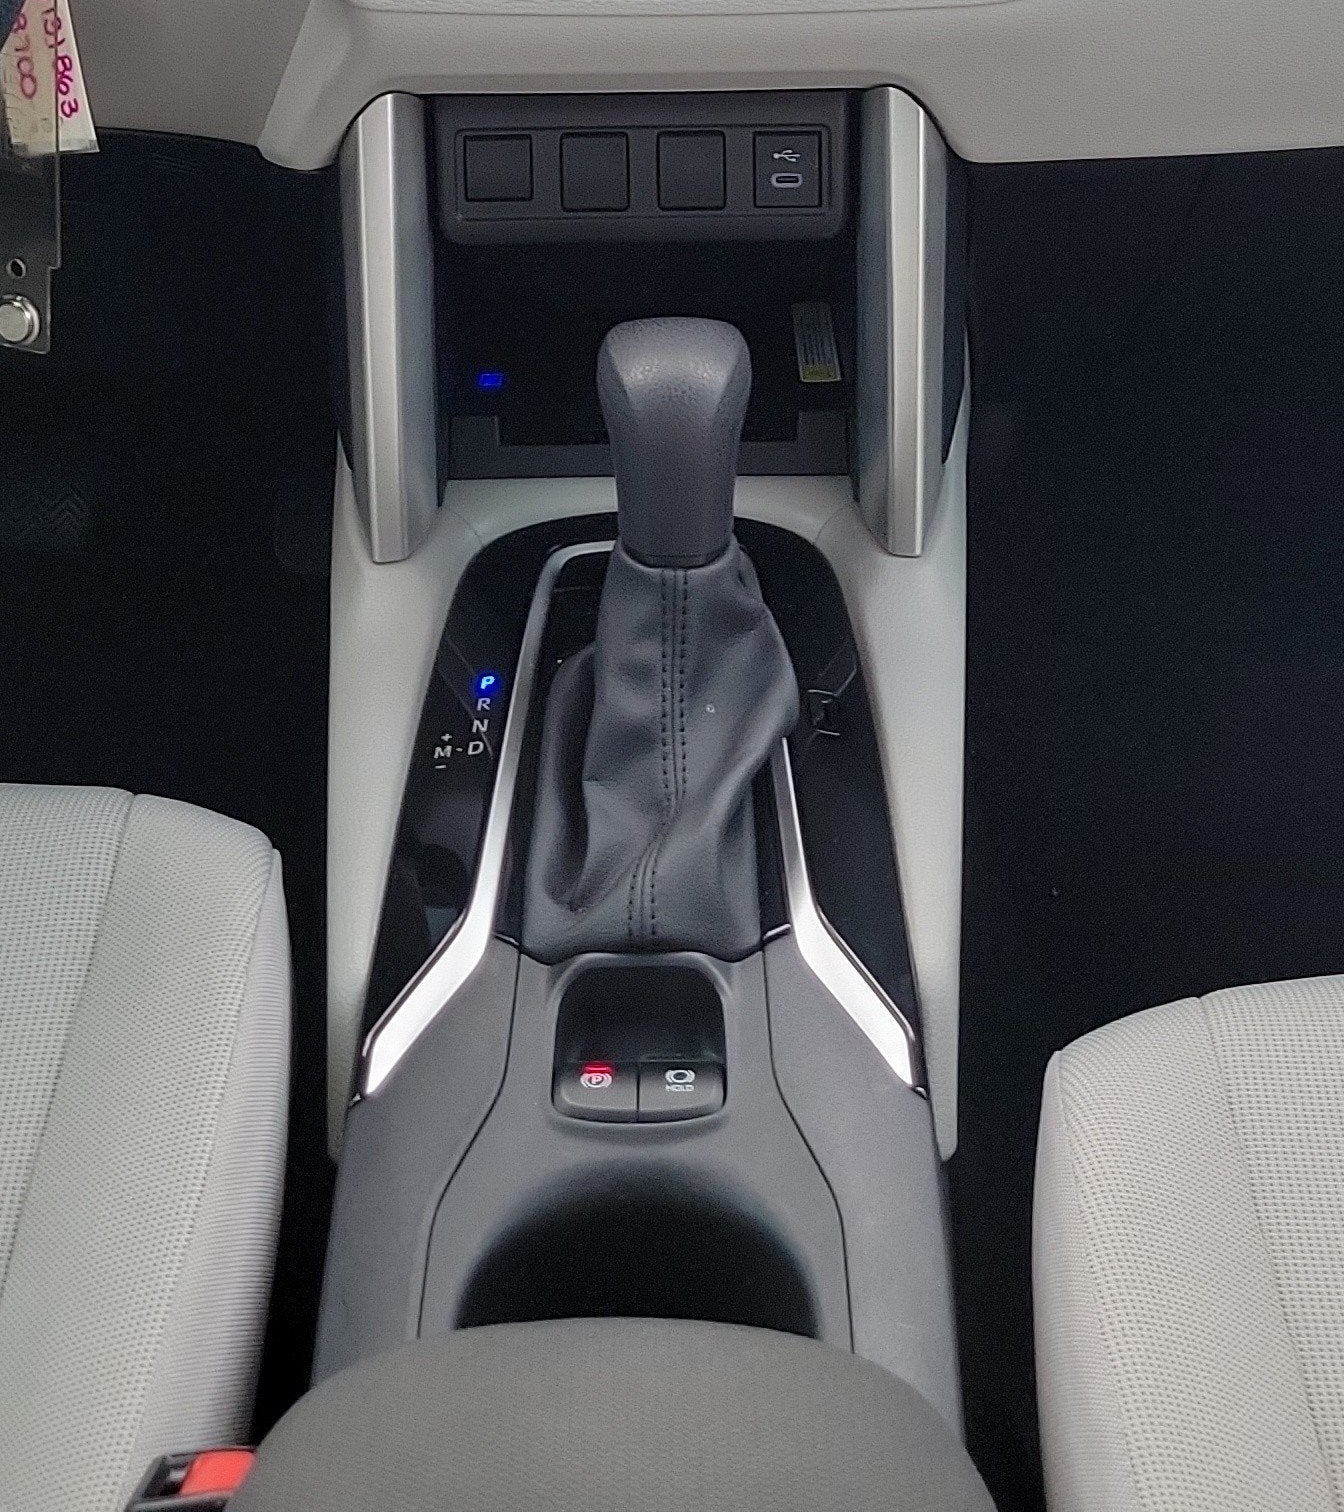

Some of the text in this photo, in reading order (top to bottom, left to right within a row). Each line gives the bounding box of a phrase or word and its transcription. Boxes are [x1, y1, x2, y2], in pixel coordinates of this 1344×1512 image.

[480, 675, 496, 690] P
[477, 697, 491, 711] R
[471, 718, 489, 733] N
[433, 744, 453, 759] M
[467, 740, 485, 756] D
